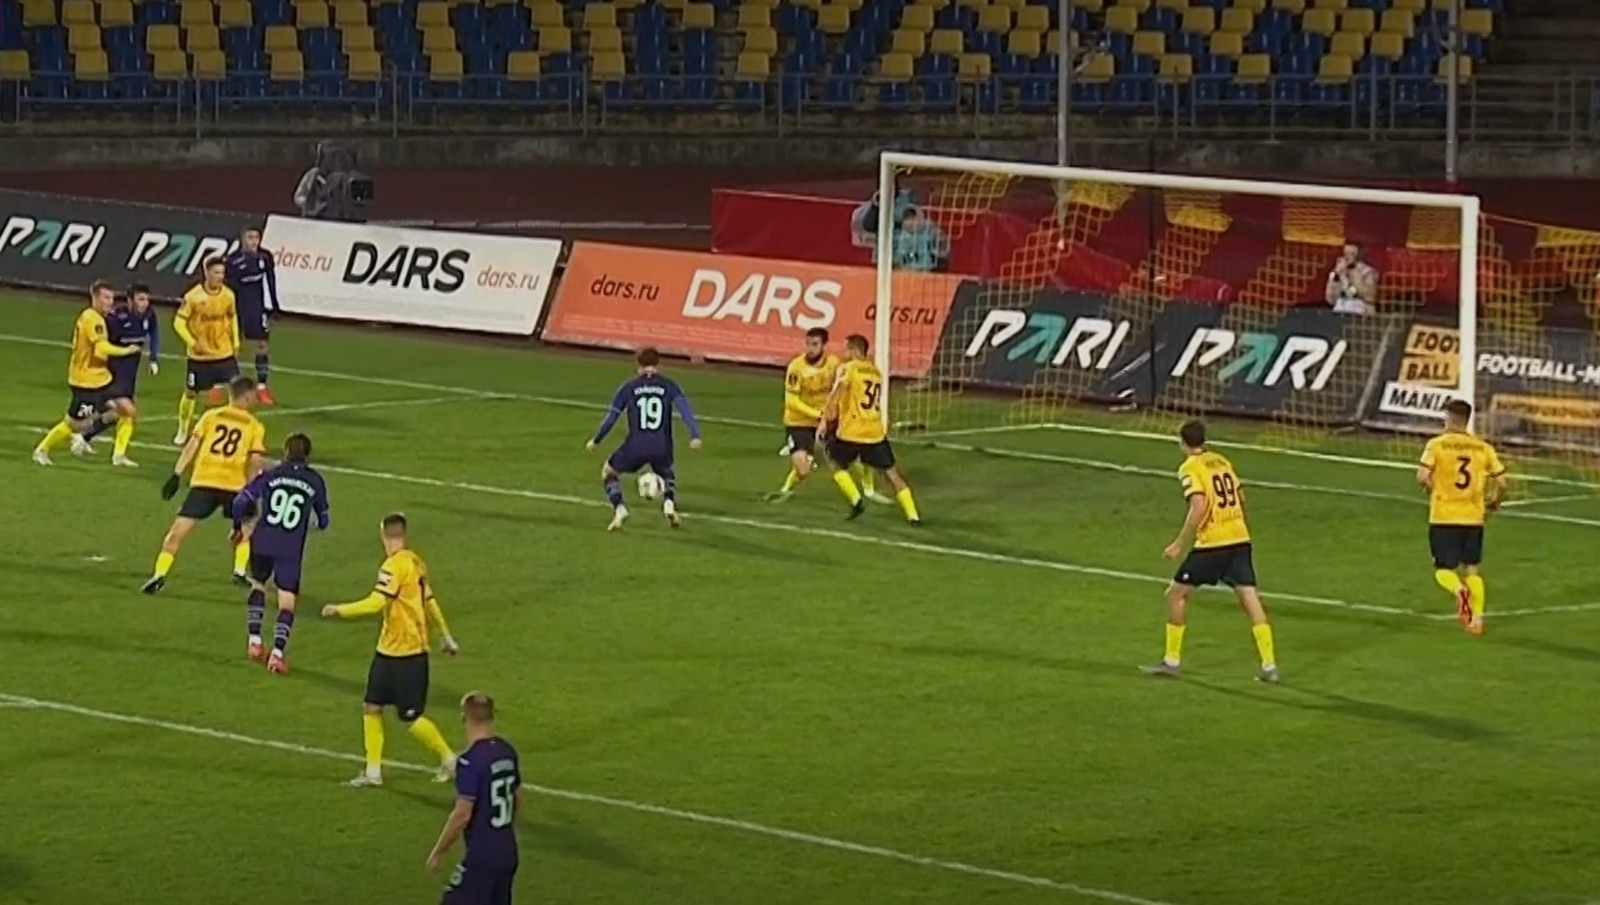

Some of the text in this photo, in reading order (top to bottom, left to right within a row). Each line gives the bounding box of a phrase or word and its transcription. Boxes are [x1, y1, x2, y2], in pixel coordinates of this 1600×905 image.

[0, 216, 106, 265] PARI
[273, 246, 333, 272] dars.ru
[342, 241, 471, 293] DARS
[477, 265, 540, 291] dars.ru
[591, 275, 660, 303] dars.ru
[682, 268, 842, 330] DARS
[965, 309, 1131, 370] PARI
[1171, 327, 1348, 391] PARI
[1405, 362, 1451, 381] BALL
[636, 395, 663, 430] 19
[210, 424, 242, 457] 28
[1454, 455, 1471, 490] 3
[266, 488, 305, 530] 96
[1212, 472, 1238, 510] 99
